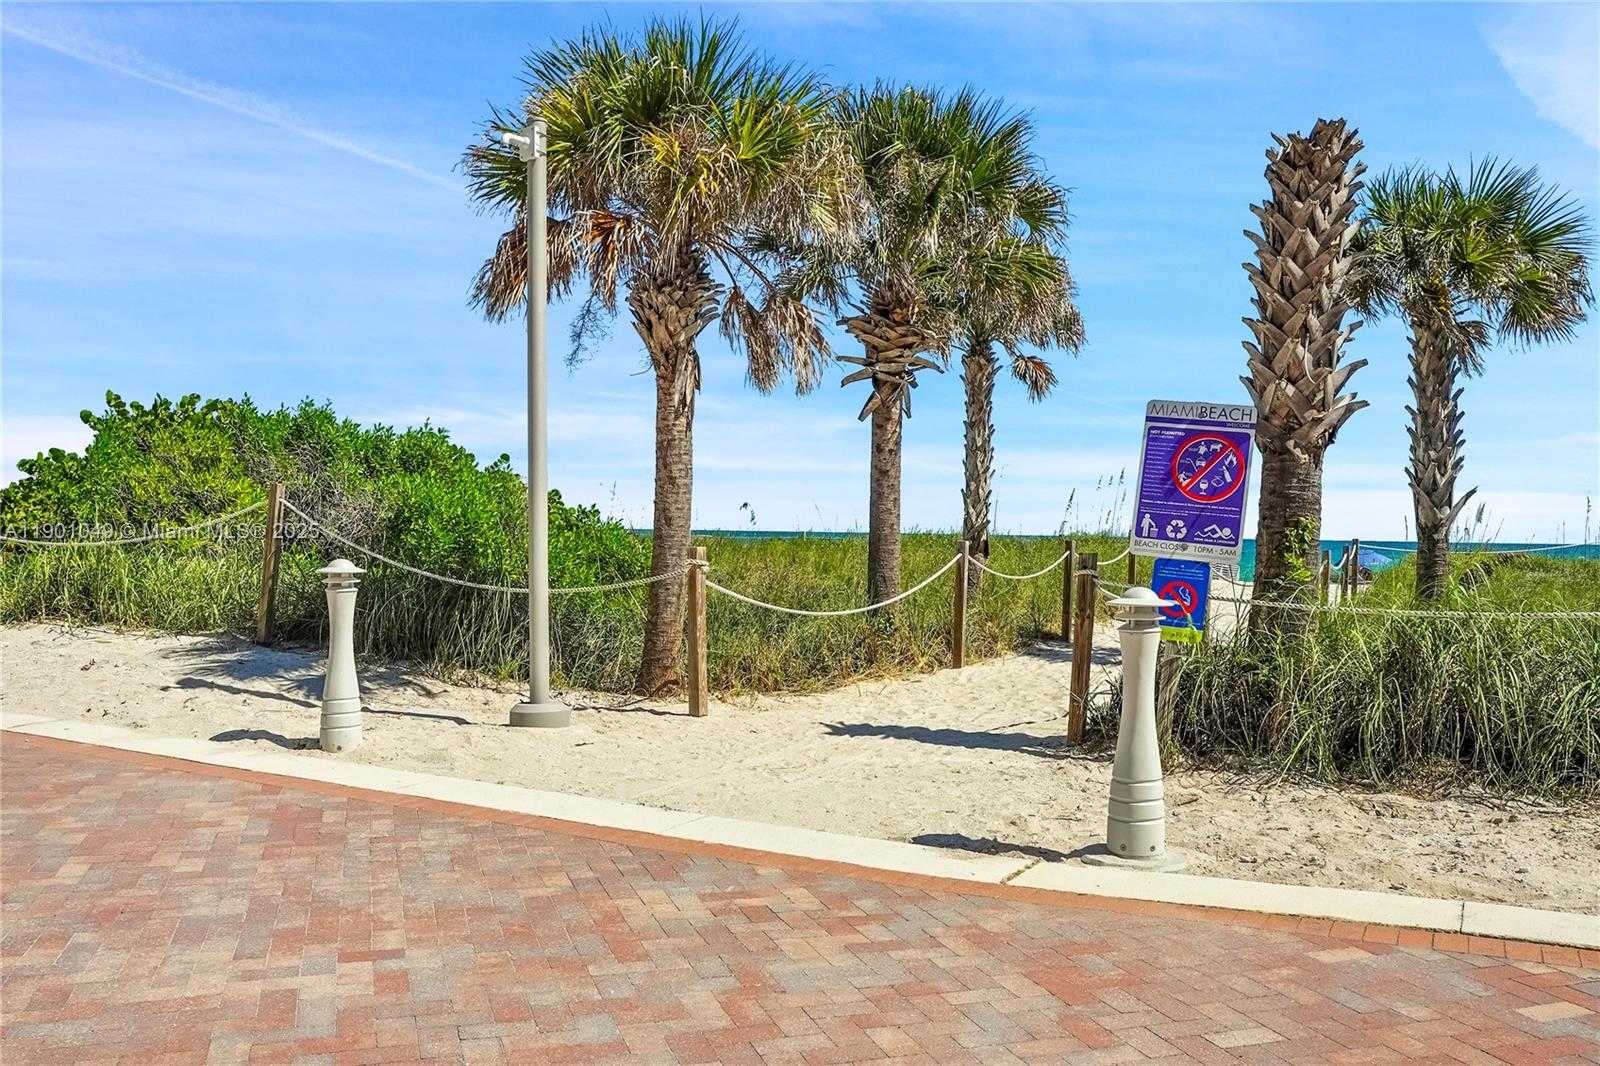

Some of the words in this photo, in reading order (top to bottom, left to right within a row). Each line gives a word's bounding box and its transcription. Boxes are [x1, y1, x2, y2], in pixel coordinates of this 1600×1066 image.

[1135, 539, 1159, 549] BEACH
[1194, 544, 1214, 554] 10PM
[1219, 548, 1237, 557] 5AM
